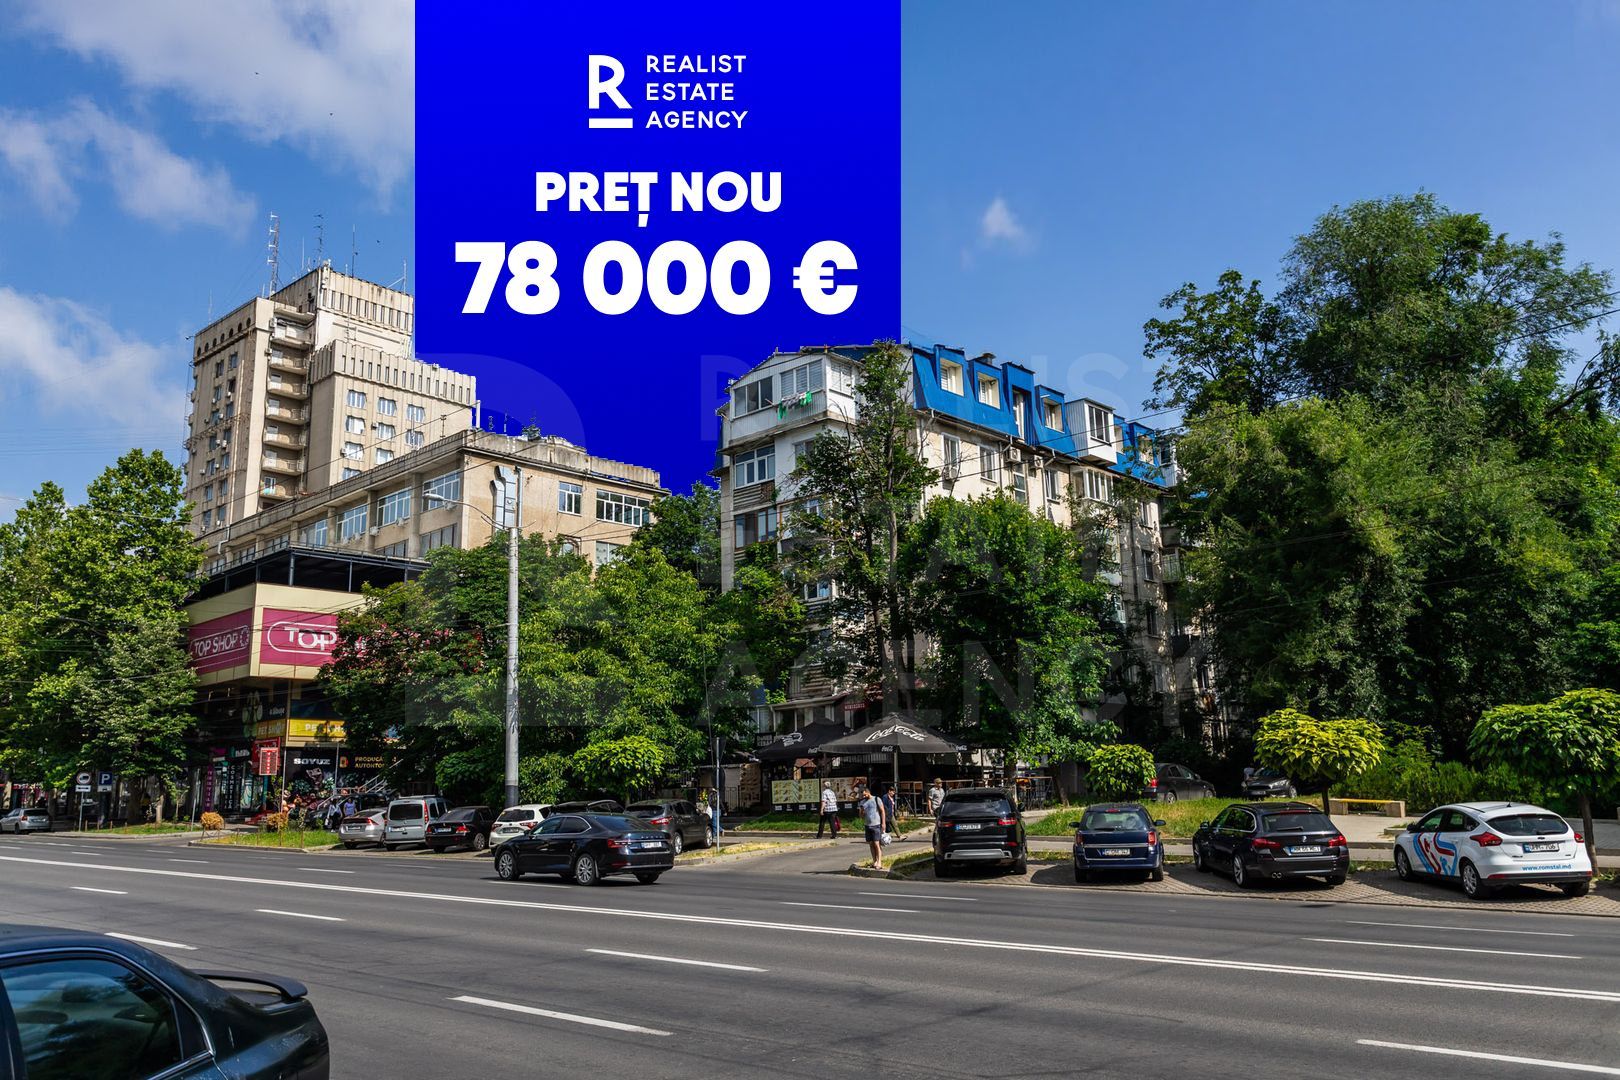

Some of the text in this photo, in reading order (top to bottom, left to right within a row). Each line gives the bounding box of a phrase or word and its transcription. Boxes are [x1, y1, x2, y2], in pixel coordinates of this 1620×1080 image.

[195, 632, 238, 656] TOP SHOP
[284, 627, 336, 650] TOP
[293, 757, 331, 765] SOYUZ
[101, 773, 111, 784] P
[1521, 863, 1572, 871] www.romstal.md
